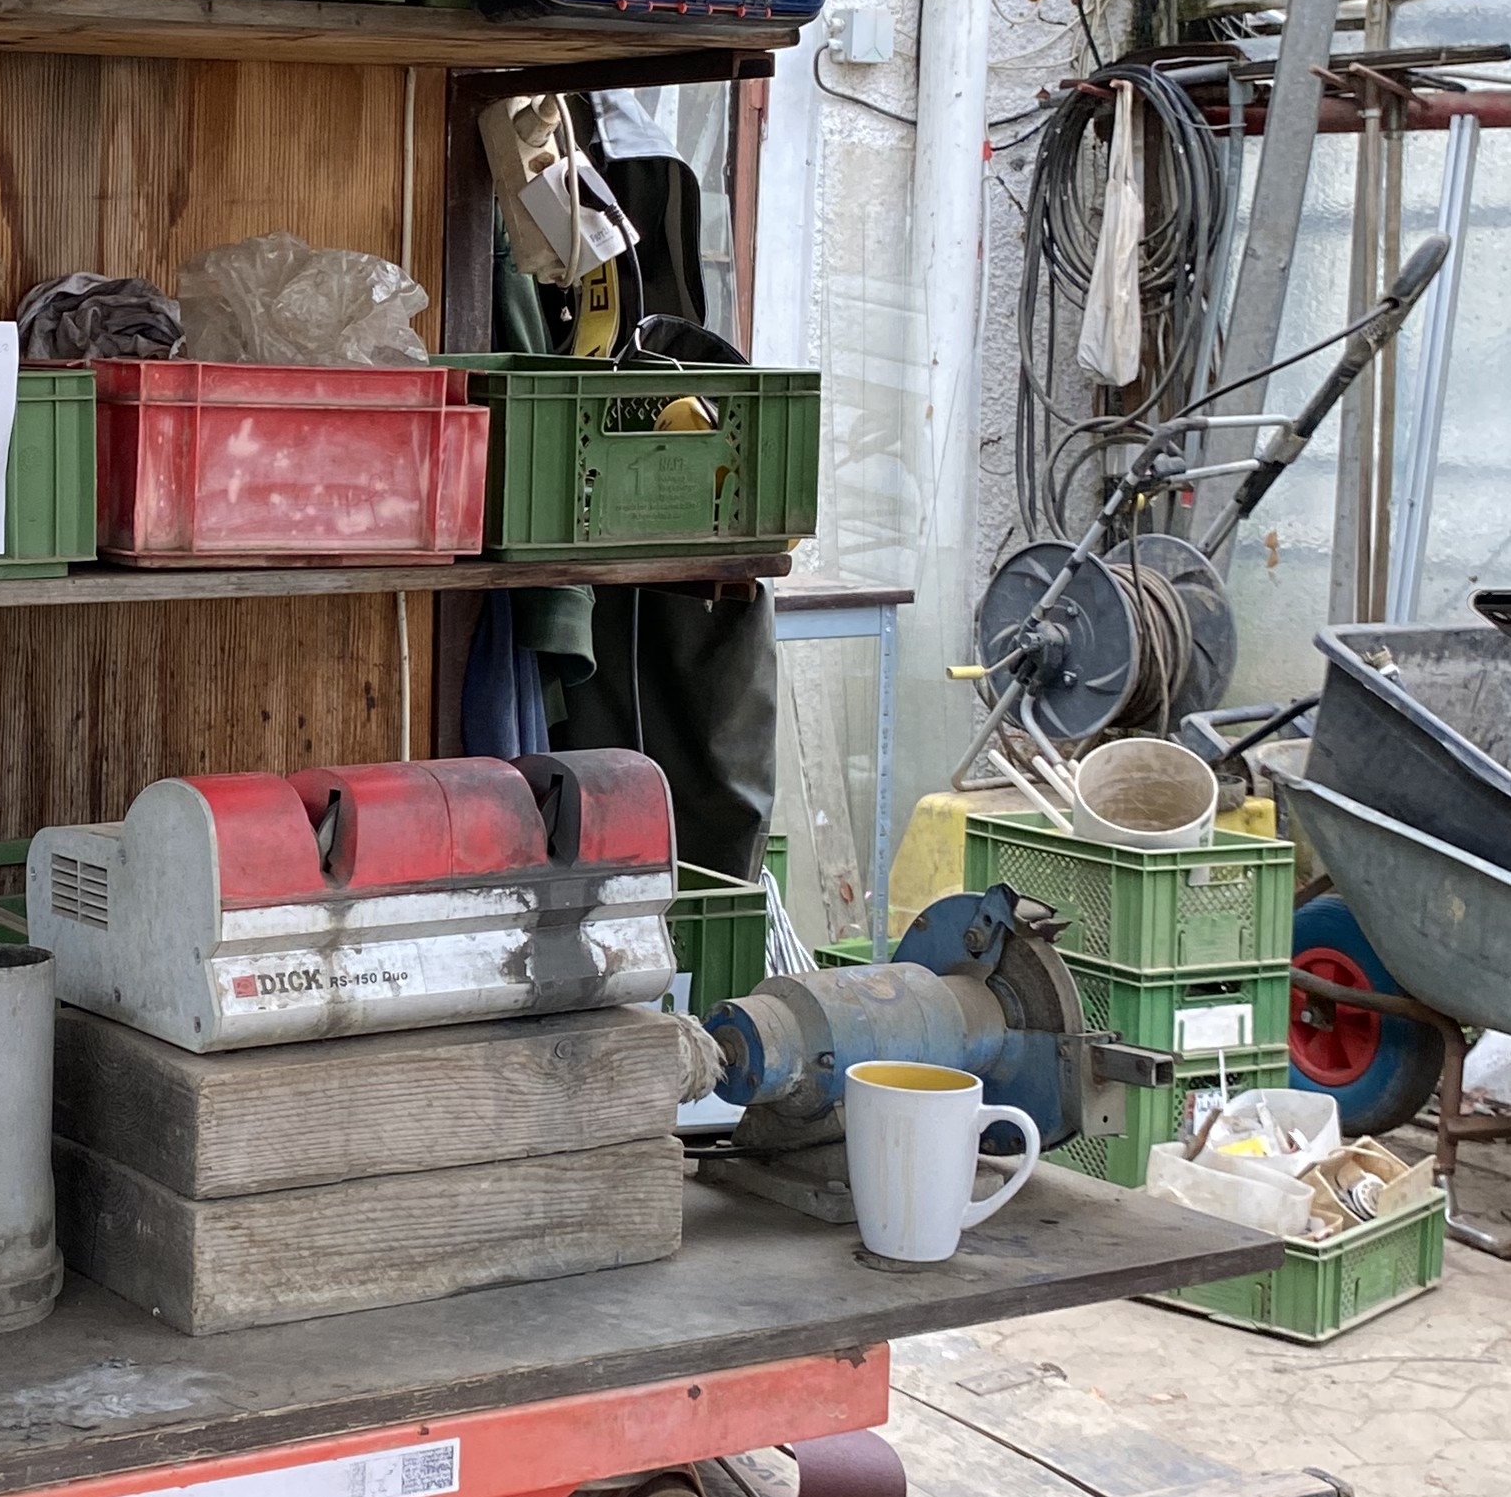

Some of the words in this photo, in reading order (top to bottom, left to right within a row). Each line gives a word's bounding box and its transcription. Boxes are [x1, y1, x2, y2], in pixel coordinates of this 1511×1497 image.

[257, 969, 323, 995] DICK
[330, 972, 377, 989] RS-150
[382, 970, 408, 983] Duo
